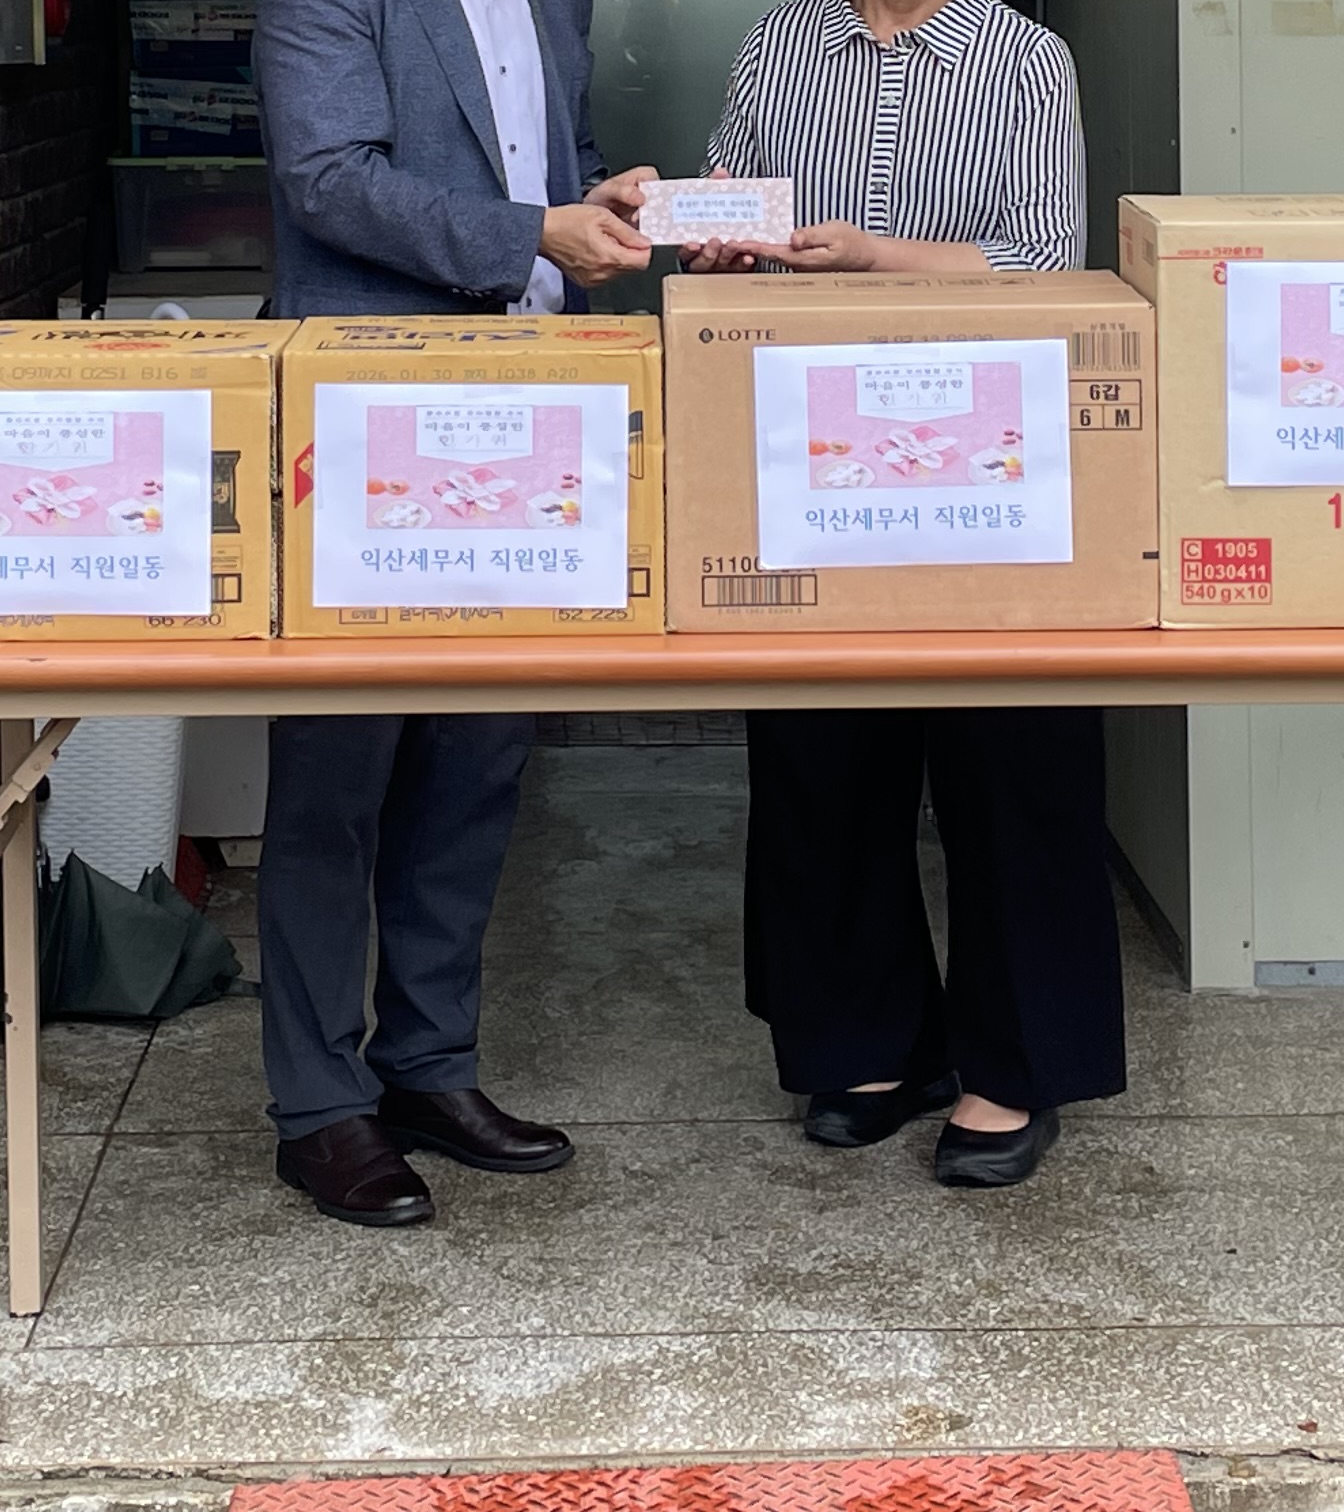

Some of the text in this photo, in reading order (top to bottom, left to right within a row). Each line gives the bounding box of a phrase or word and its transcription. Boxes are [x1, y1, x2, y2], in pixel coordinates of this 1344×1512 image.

[718, 329, 776, 341] LOTTE
[1114, 408, 1130, 427] M
[805, 504, 1027, 532] 익산세무서 직원일동
[1186, 542, 1258, 558] C 1905
[70, 555, 166, 580] 직원일동
[360, 547, 584, 573] 익산세무서 직원일동
[1187, 564, 1266, 580] H 030411
